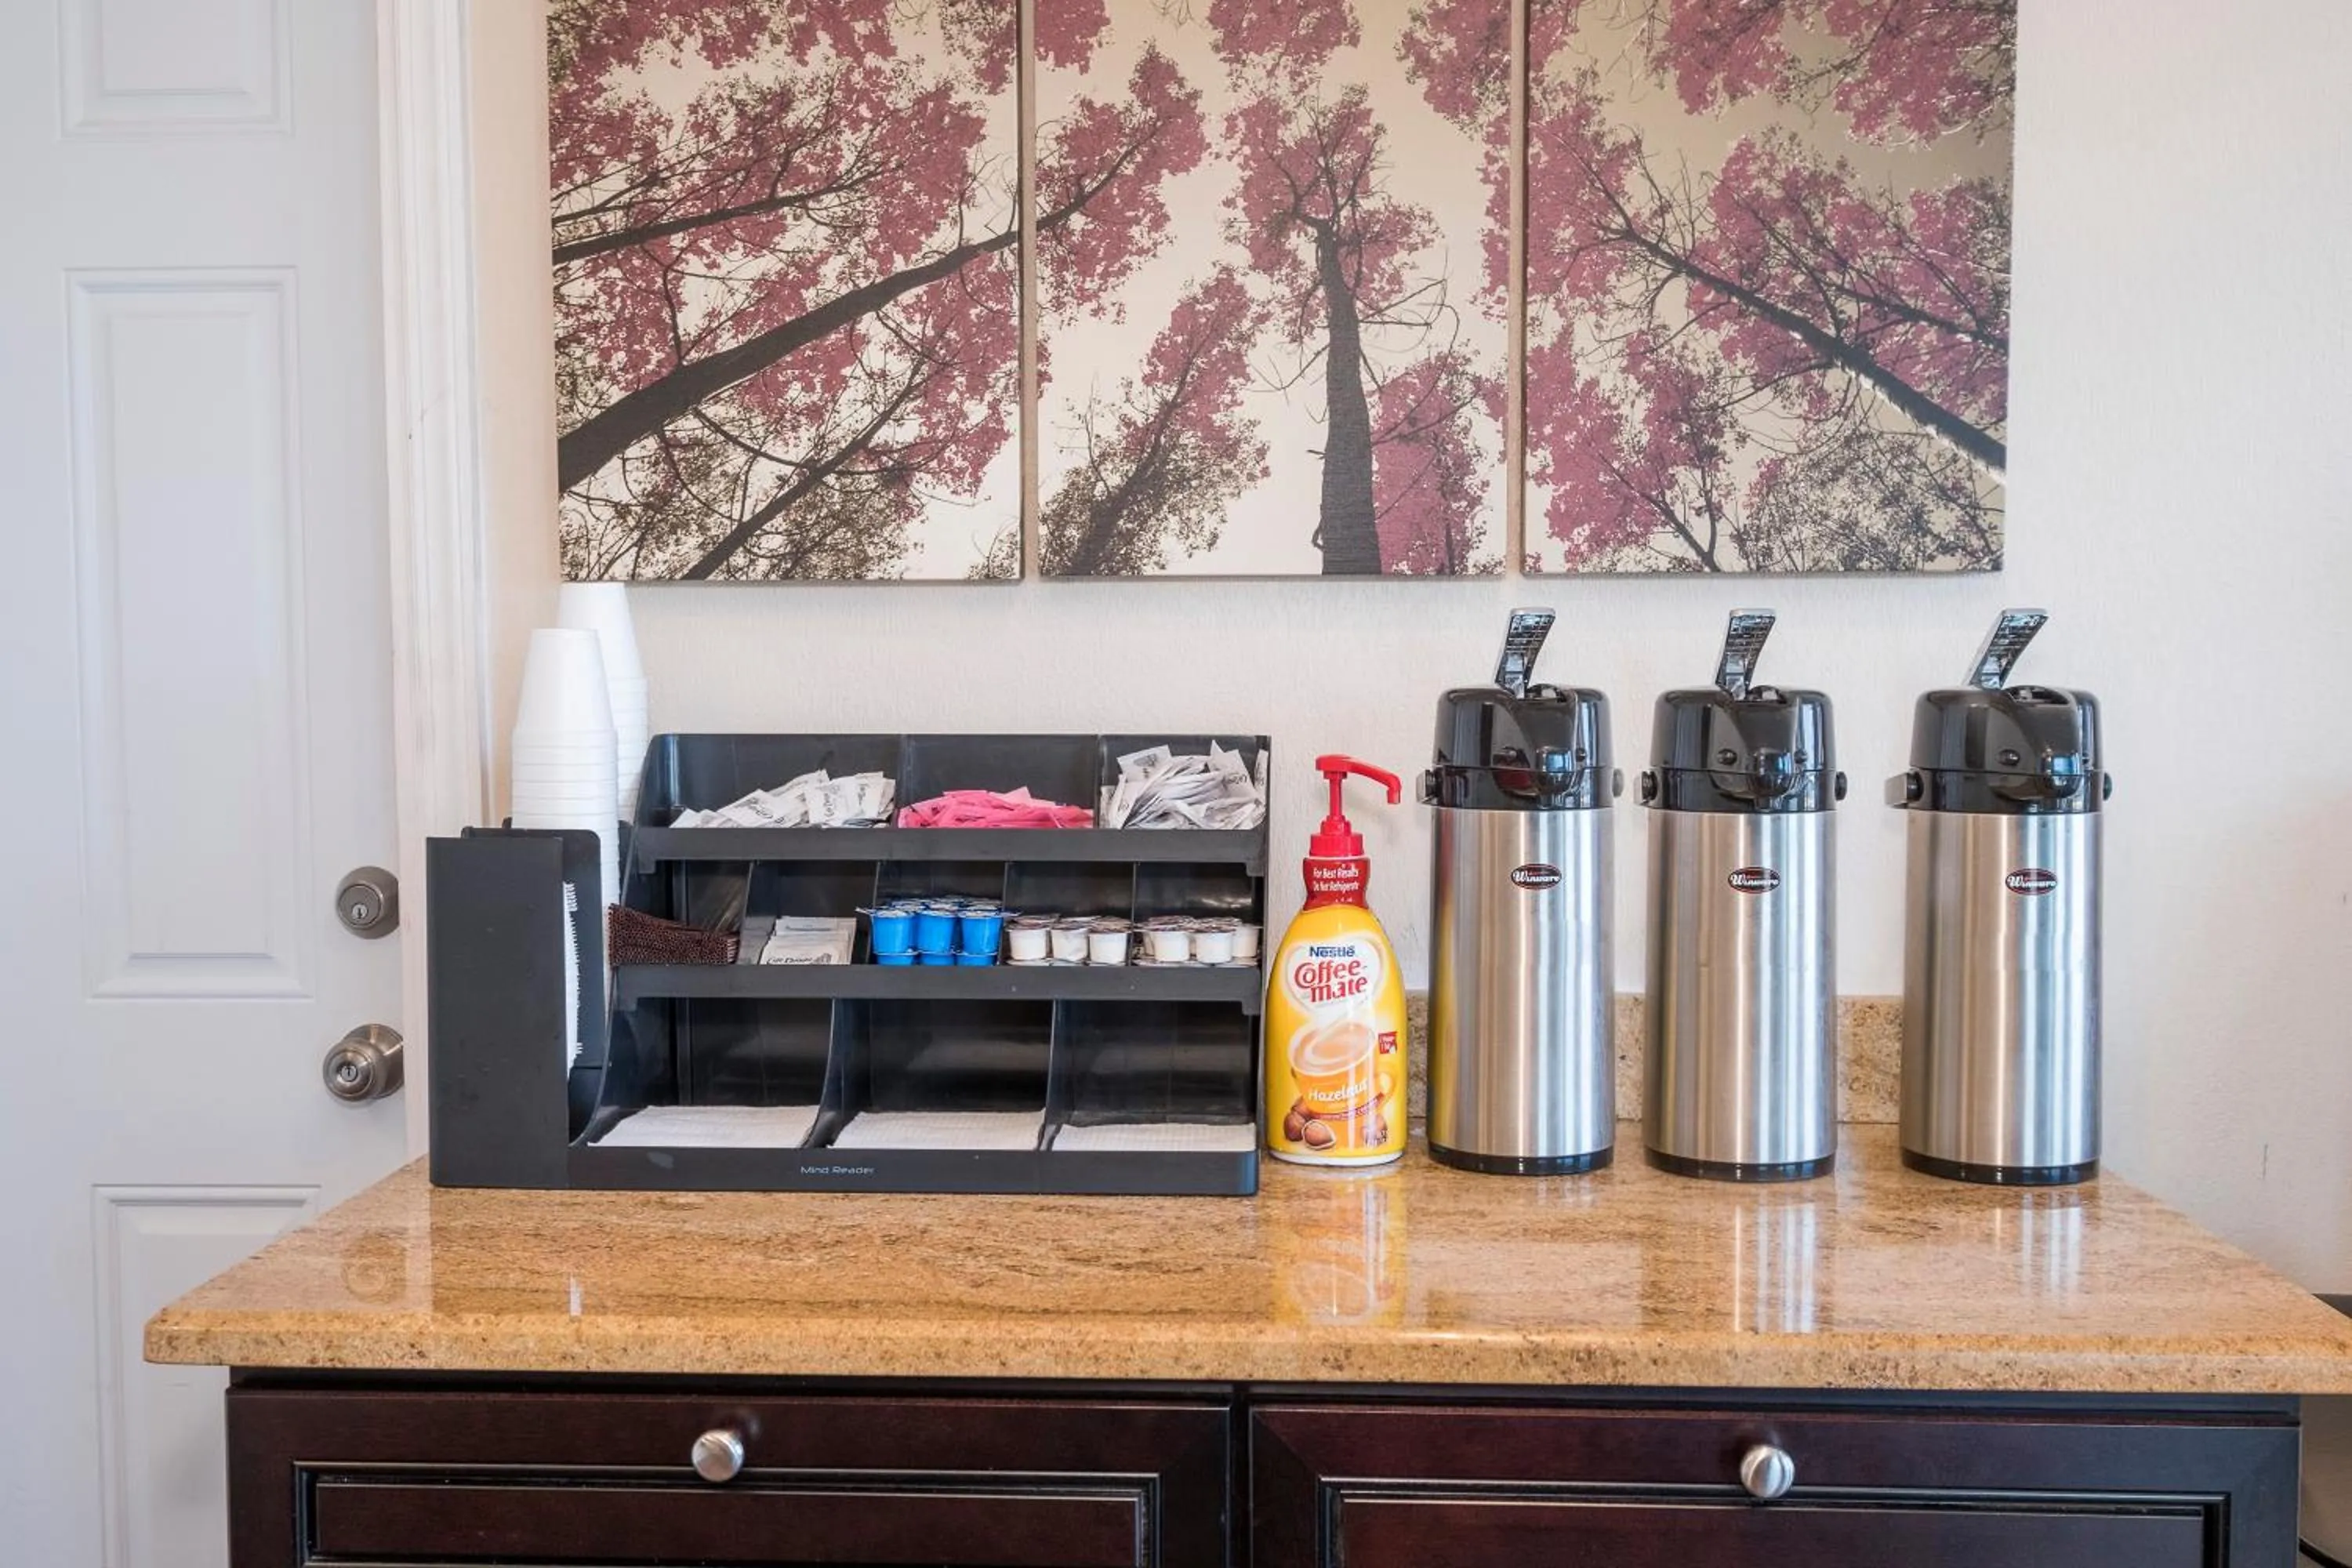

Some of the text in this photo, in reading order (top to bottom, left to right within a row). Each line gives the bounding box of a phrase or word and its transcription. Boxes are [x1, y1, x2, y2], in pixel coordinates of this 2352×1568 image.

[1310, 976, 1368, 1003] mate
[800, 1166, 875, 1174] Mind Reader
